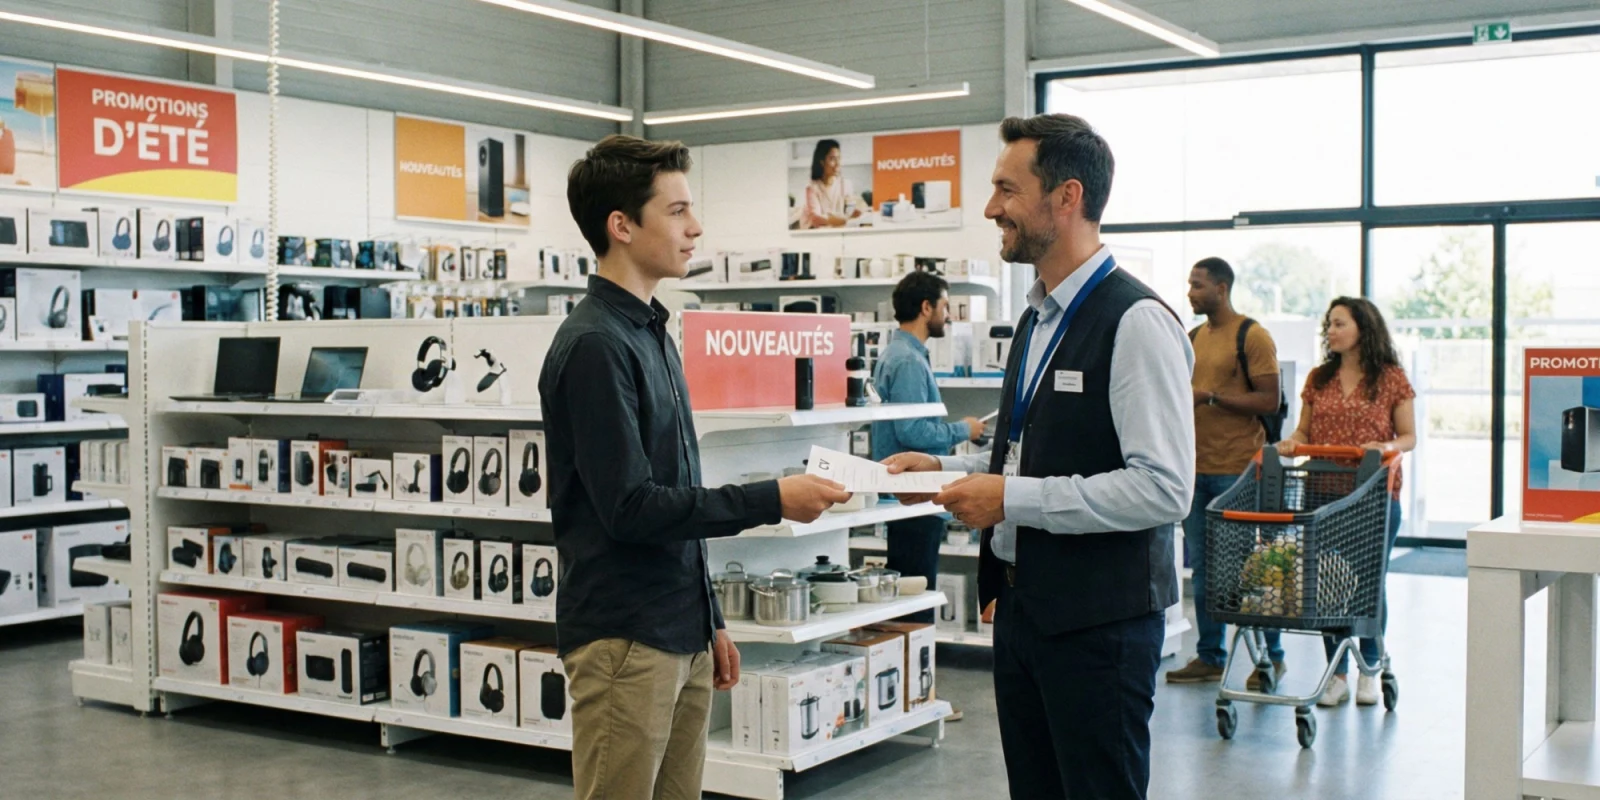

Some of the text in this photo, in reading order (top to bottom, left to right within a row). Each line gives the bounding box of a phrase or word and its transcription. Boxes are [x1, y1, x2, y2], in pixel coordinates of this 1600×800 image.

[91, 88, 209, 119] PROMOTIONS
[93, 114, 209, 166] D’ÉTÉ
[399, 160, 463, 178] NOUVEAUTÉS
[877, 152, 956, 171] NOUVEAUTÉS
[705, 324, 834, 357] NOUVEAUTÉS
[818, 457, 830, 471] CV
